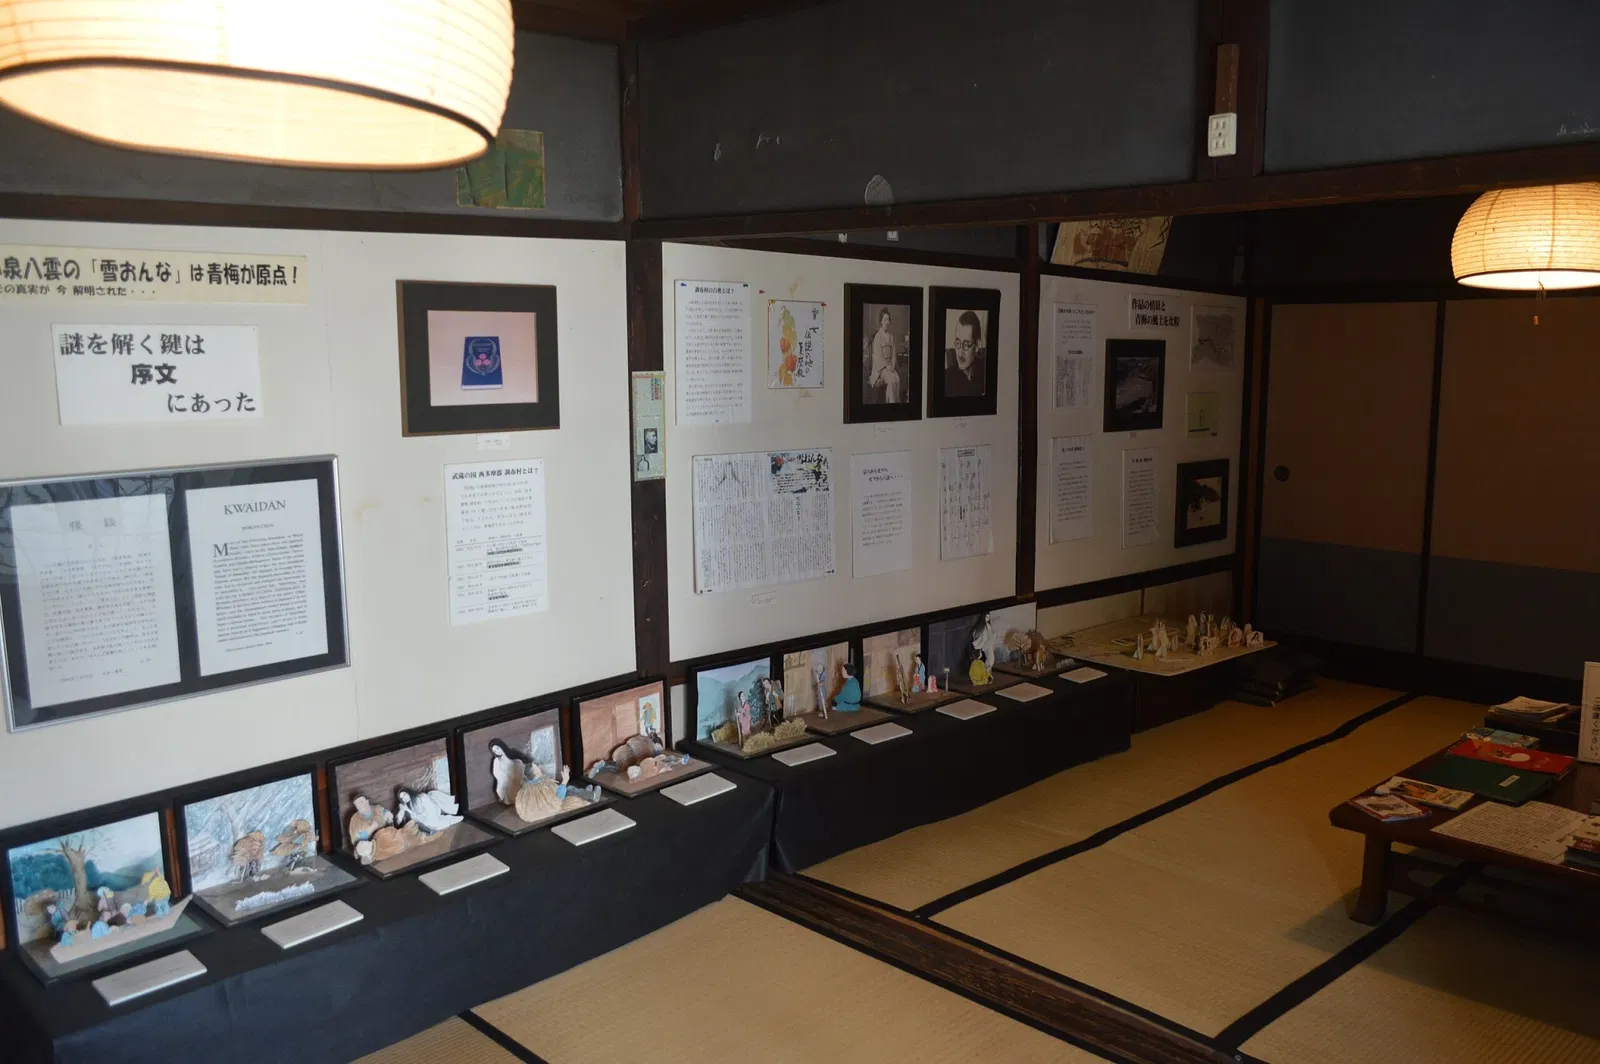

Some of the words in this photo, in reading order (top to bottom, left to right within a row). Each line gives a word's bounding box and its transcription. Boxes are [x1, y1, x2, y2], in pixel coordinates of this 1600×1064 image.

[59, 333, 206, 357] 謎を解く鍵は
[131, 363, 178, 386] 序文
[167, 392, 257, 414] にあった
[223, 499, 286, 516] KWAIDAN
